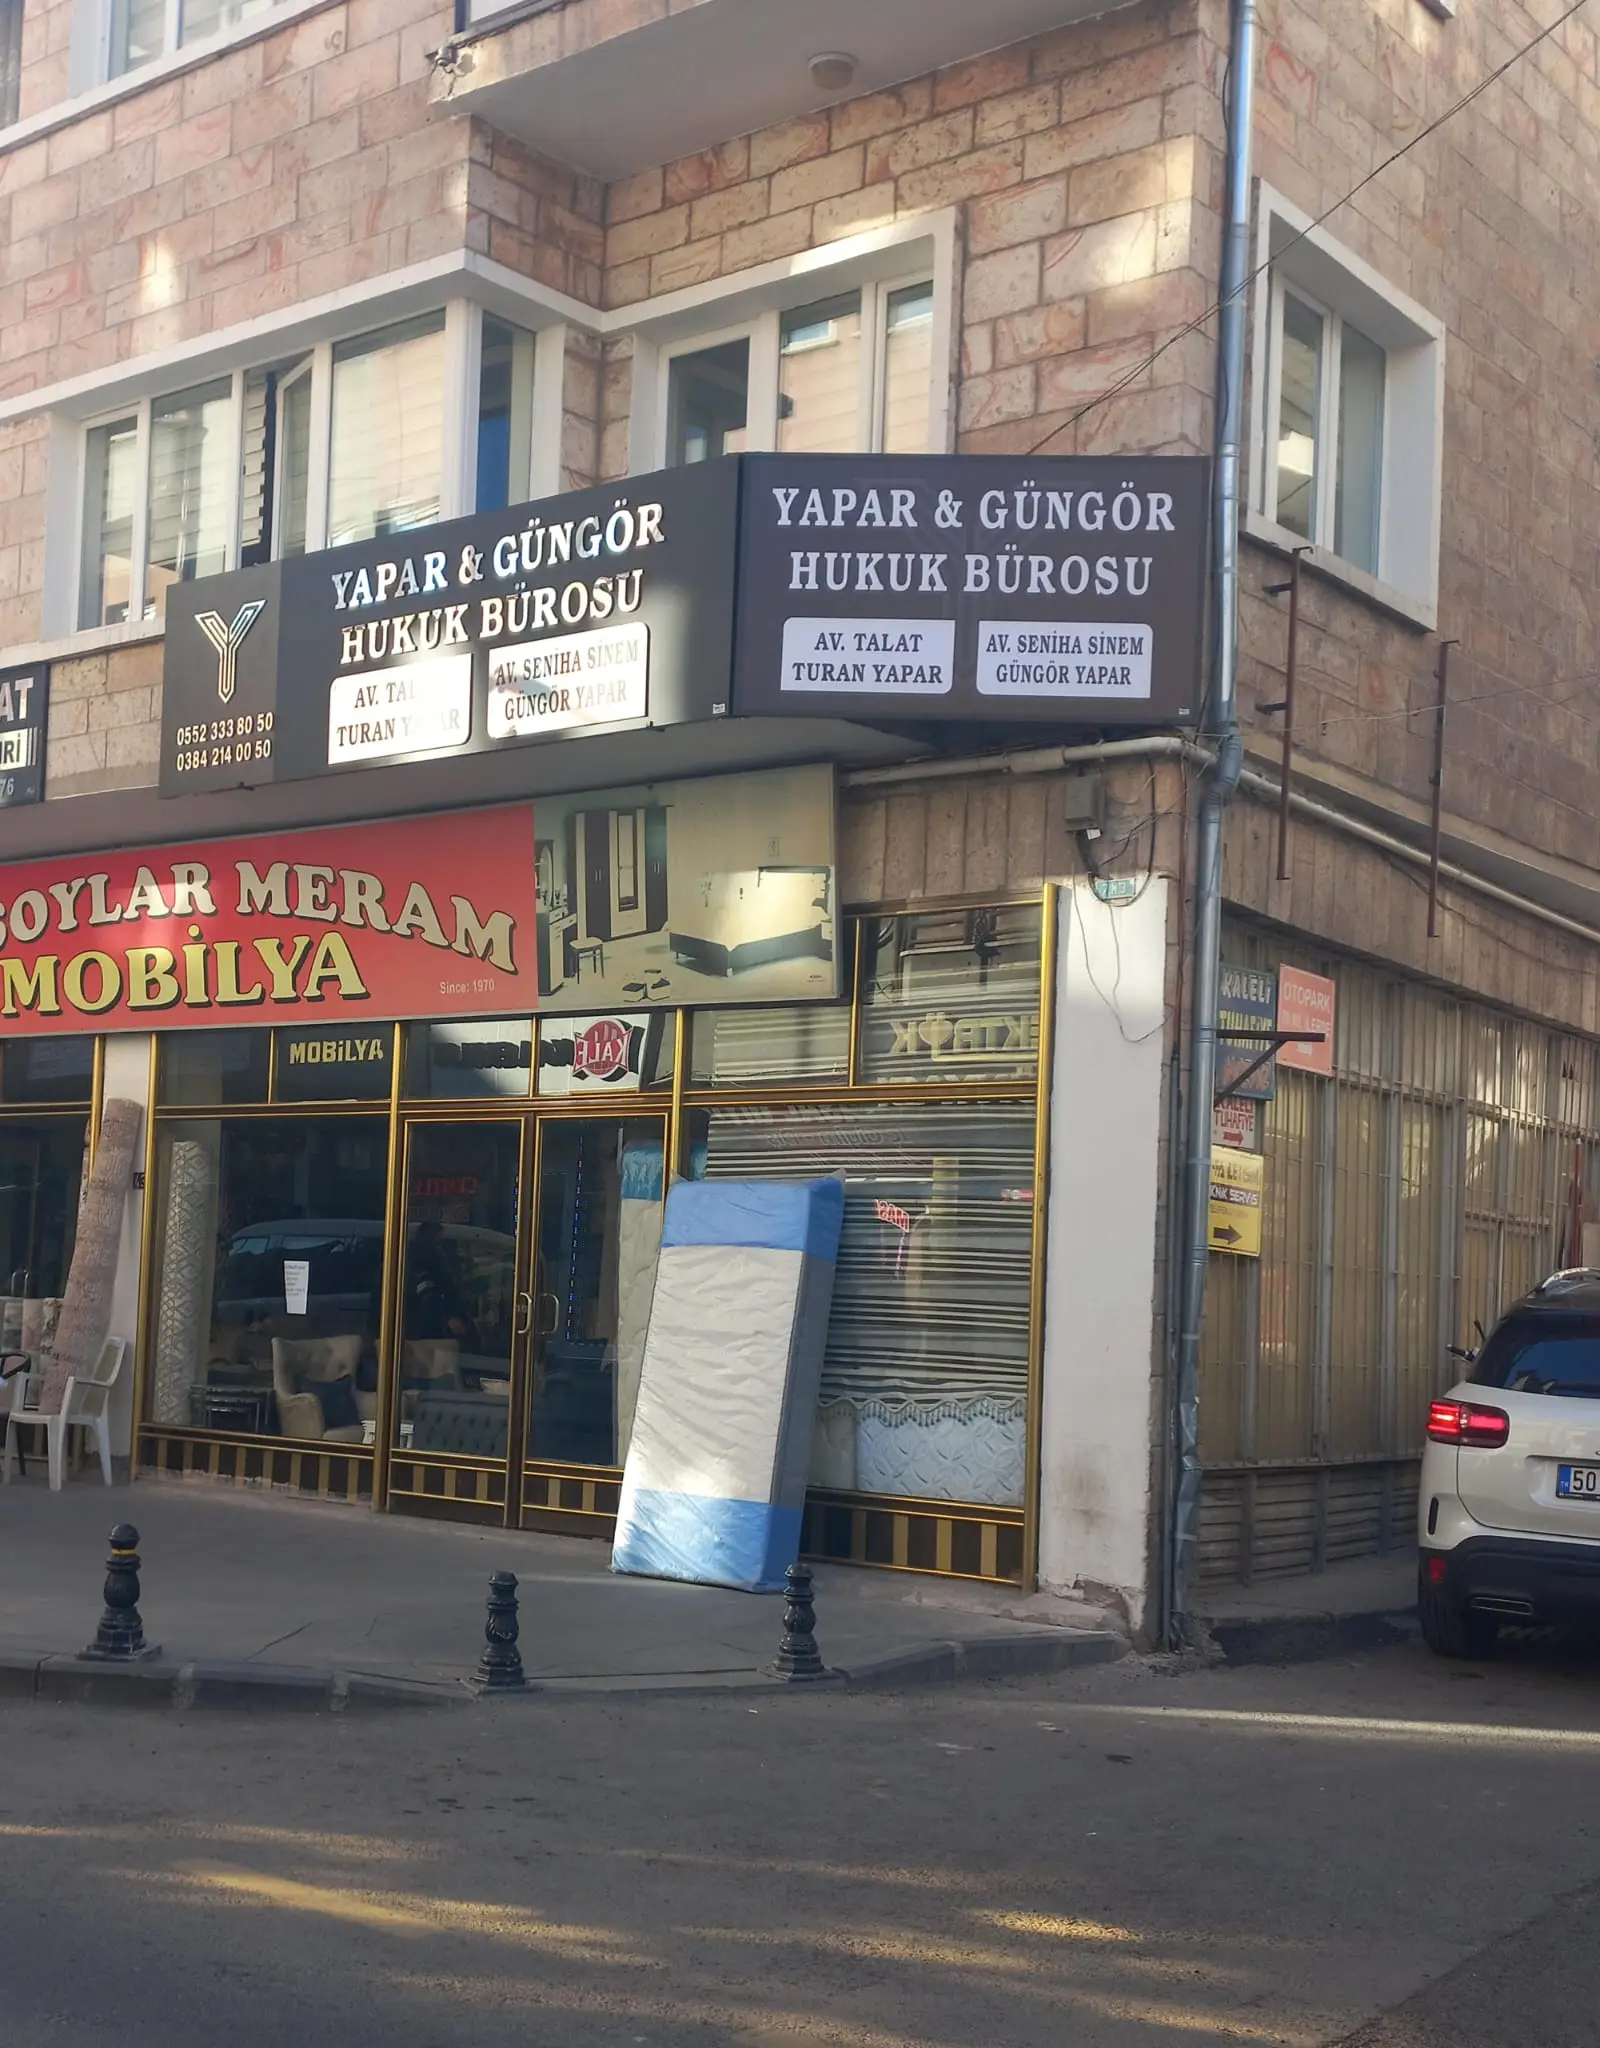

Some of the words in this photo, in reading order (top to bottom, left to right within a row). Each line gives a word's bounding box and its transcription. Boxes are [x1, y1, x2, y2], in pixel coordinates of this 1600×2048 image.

[773, 488, 918, 528] YAPAR
[934, 489, 963, 529] &
[980, 480, 1176, 532] GÜNGÖR
[331, 551, 448, 611] YAPAR
[458, 545, 484, 585] &
[493, 498, 665, 578] GÜNGÖR
[788, 552, 948, 592] HUKUK
[963, 544, 1154, 596] BÜROSU
[340, 603, 470, 664] HUKUK
[479, 569, 643, 639] BÜROSU
[815, 633, 846, 652] AV.
[854, 634, 923, 653] TALAT
[986, 634, 1012, 654] AV.
[1017, 630, 1083, 655] SENİHA
[1088, 631, 1145, 656] SİNEM
[495, 661, 518, 686] AV.
[523, 647, 581, 679] SENİHA
[587, 639, 639, 669] SİNEM
[792, 663, 866, 683] TURAN
[873, 665, 943, 685] YAPAR
[996, 659, 1069, 685] GÜNGÖR
[1075, 666, 1131, 686] YAPAR
[354, 685, 380, 708] AV.
[505, 684, 571, 720] GÜNGÖR
[576, 680, 628, 709] YAPAR
[177, 724, 207, 746] 0552
[211, 719, 234, 740] 333
[237, 715, 253, 735] 80
[257, 712, 274, 731] 50
[336, 718, 397, 747] TURAN
[177, 749, 207, 771] 0384
[211, 746, 232, 766] 214
[236, 742, 251, 762] 00
[255, 739, 271, 758] 50
[0, 861, 217, 951] OYLAR
[235, 861, 519, 974] MERAM
[0, 924, 369, 1018] MOBİLYA
[439, 981, 470, 995] Since:
[472, 979, 496, 993] 1970
[1283, 982, 1331, 1013] OTOPARK
[1573, 1470, 1596, 1491] 50
